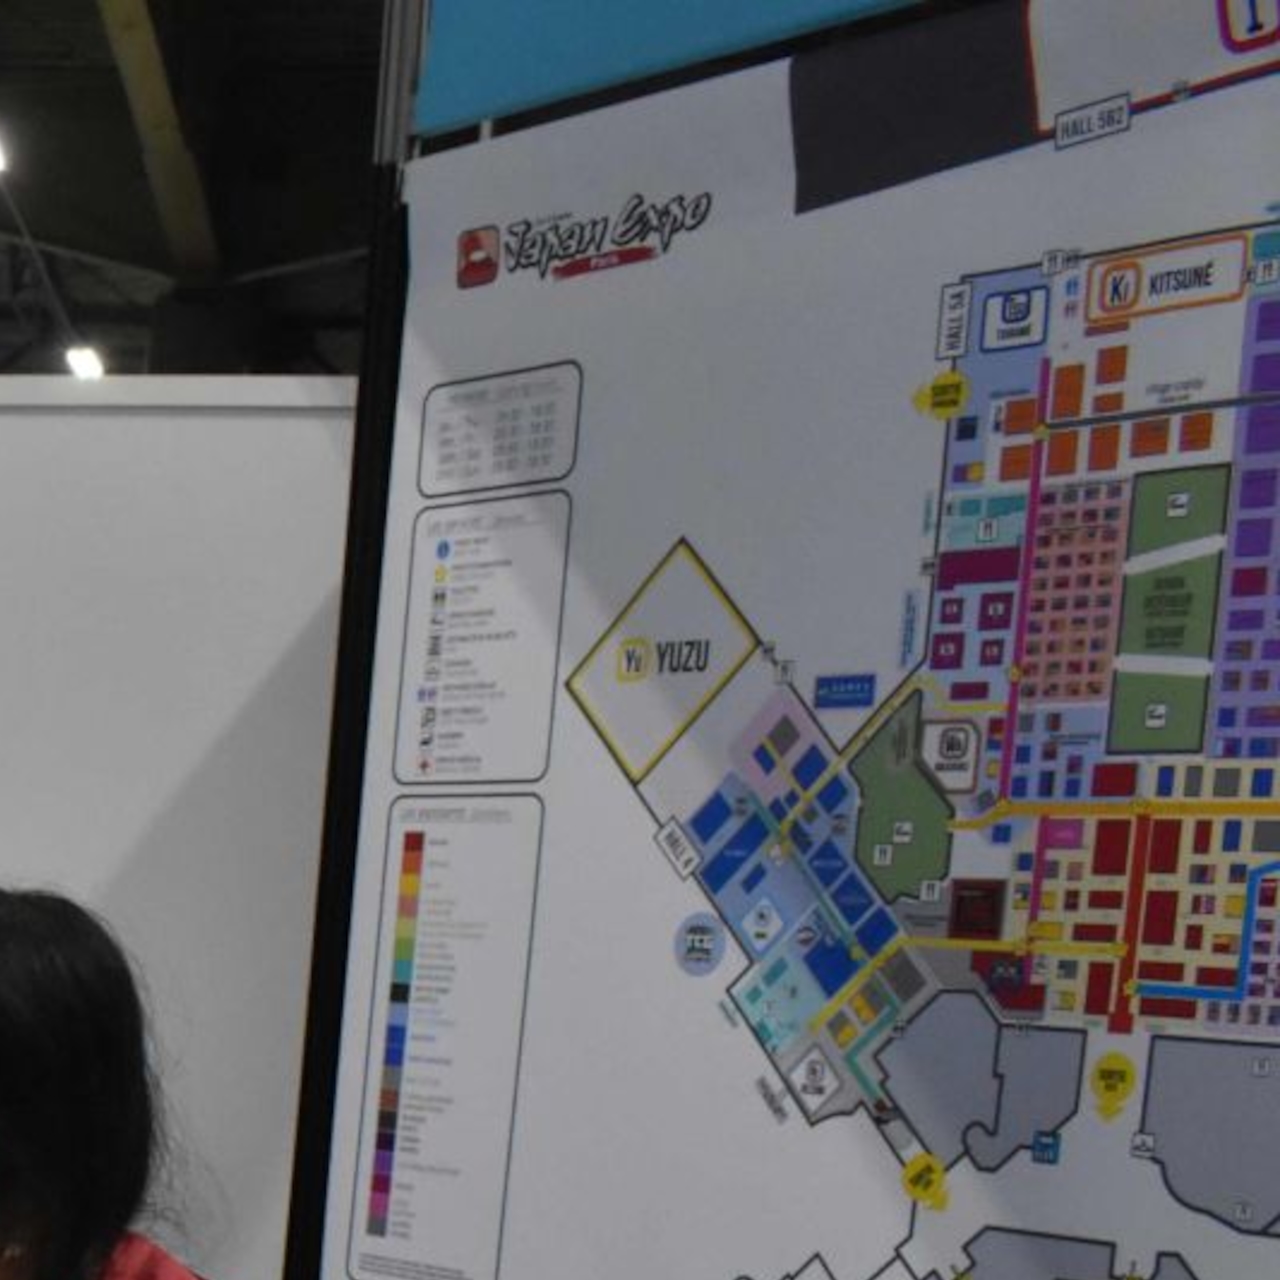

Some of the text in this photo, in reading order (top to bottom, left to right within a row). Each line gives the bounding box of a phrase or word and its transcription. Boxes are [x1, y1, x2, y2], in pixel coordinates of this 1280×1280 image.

[1060, 115, 1093, 140] HALL
[504, 191, 712, 280] Japan Expo
[1147, 260, 1215, 297] KITSUNÉ
[945, 312, 964, 352] HALL
[655, 639, 711, 673] YUZU
